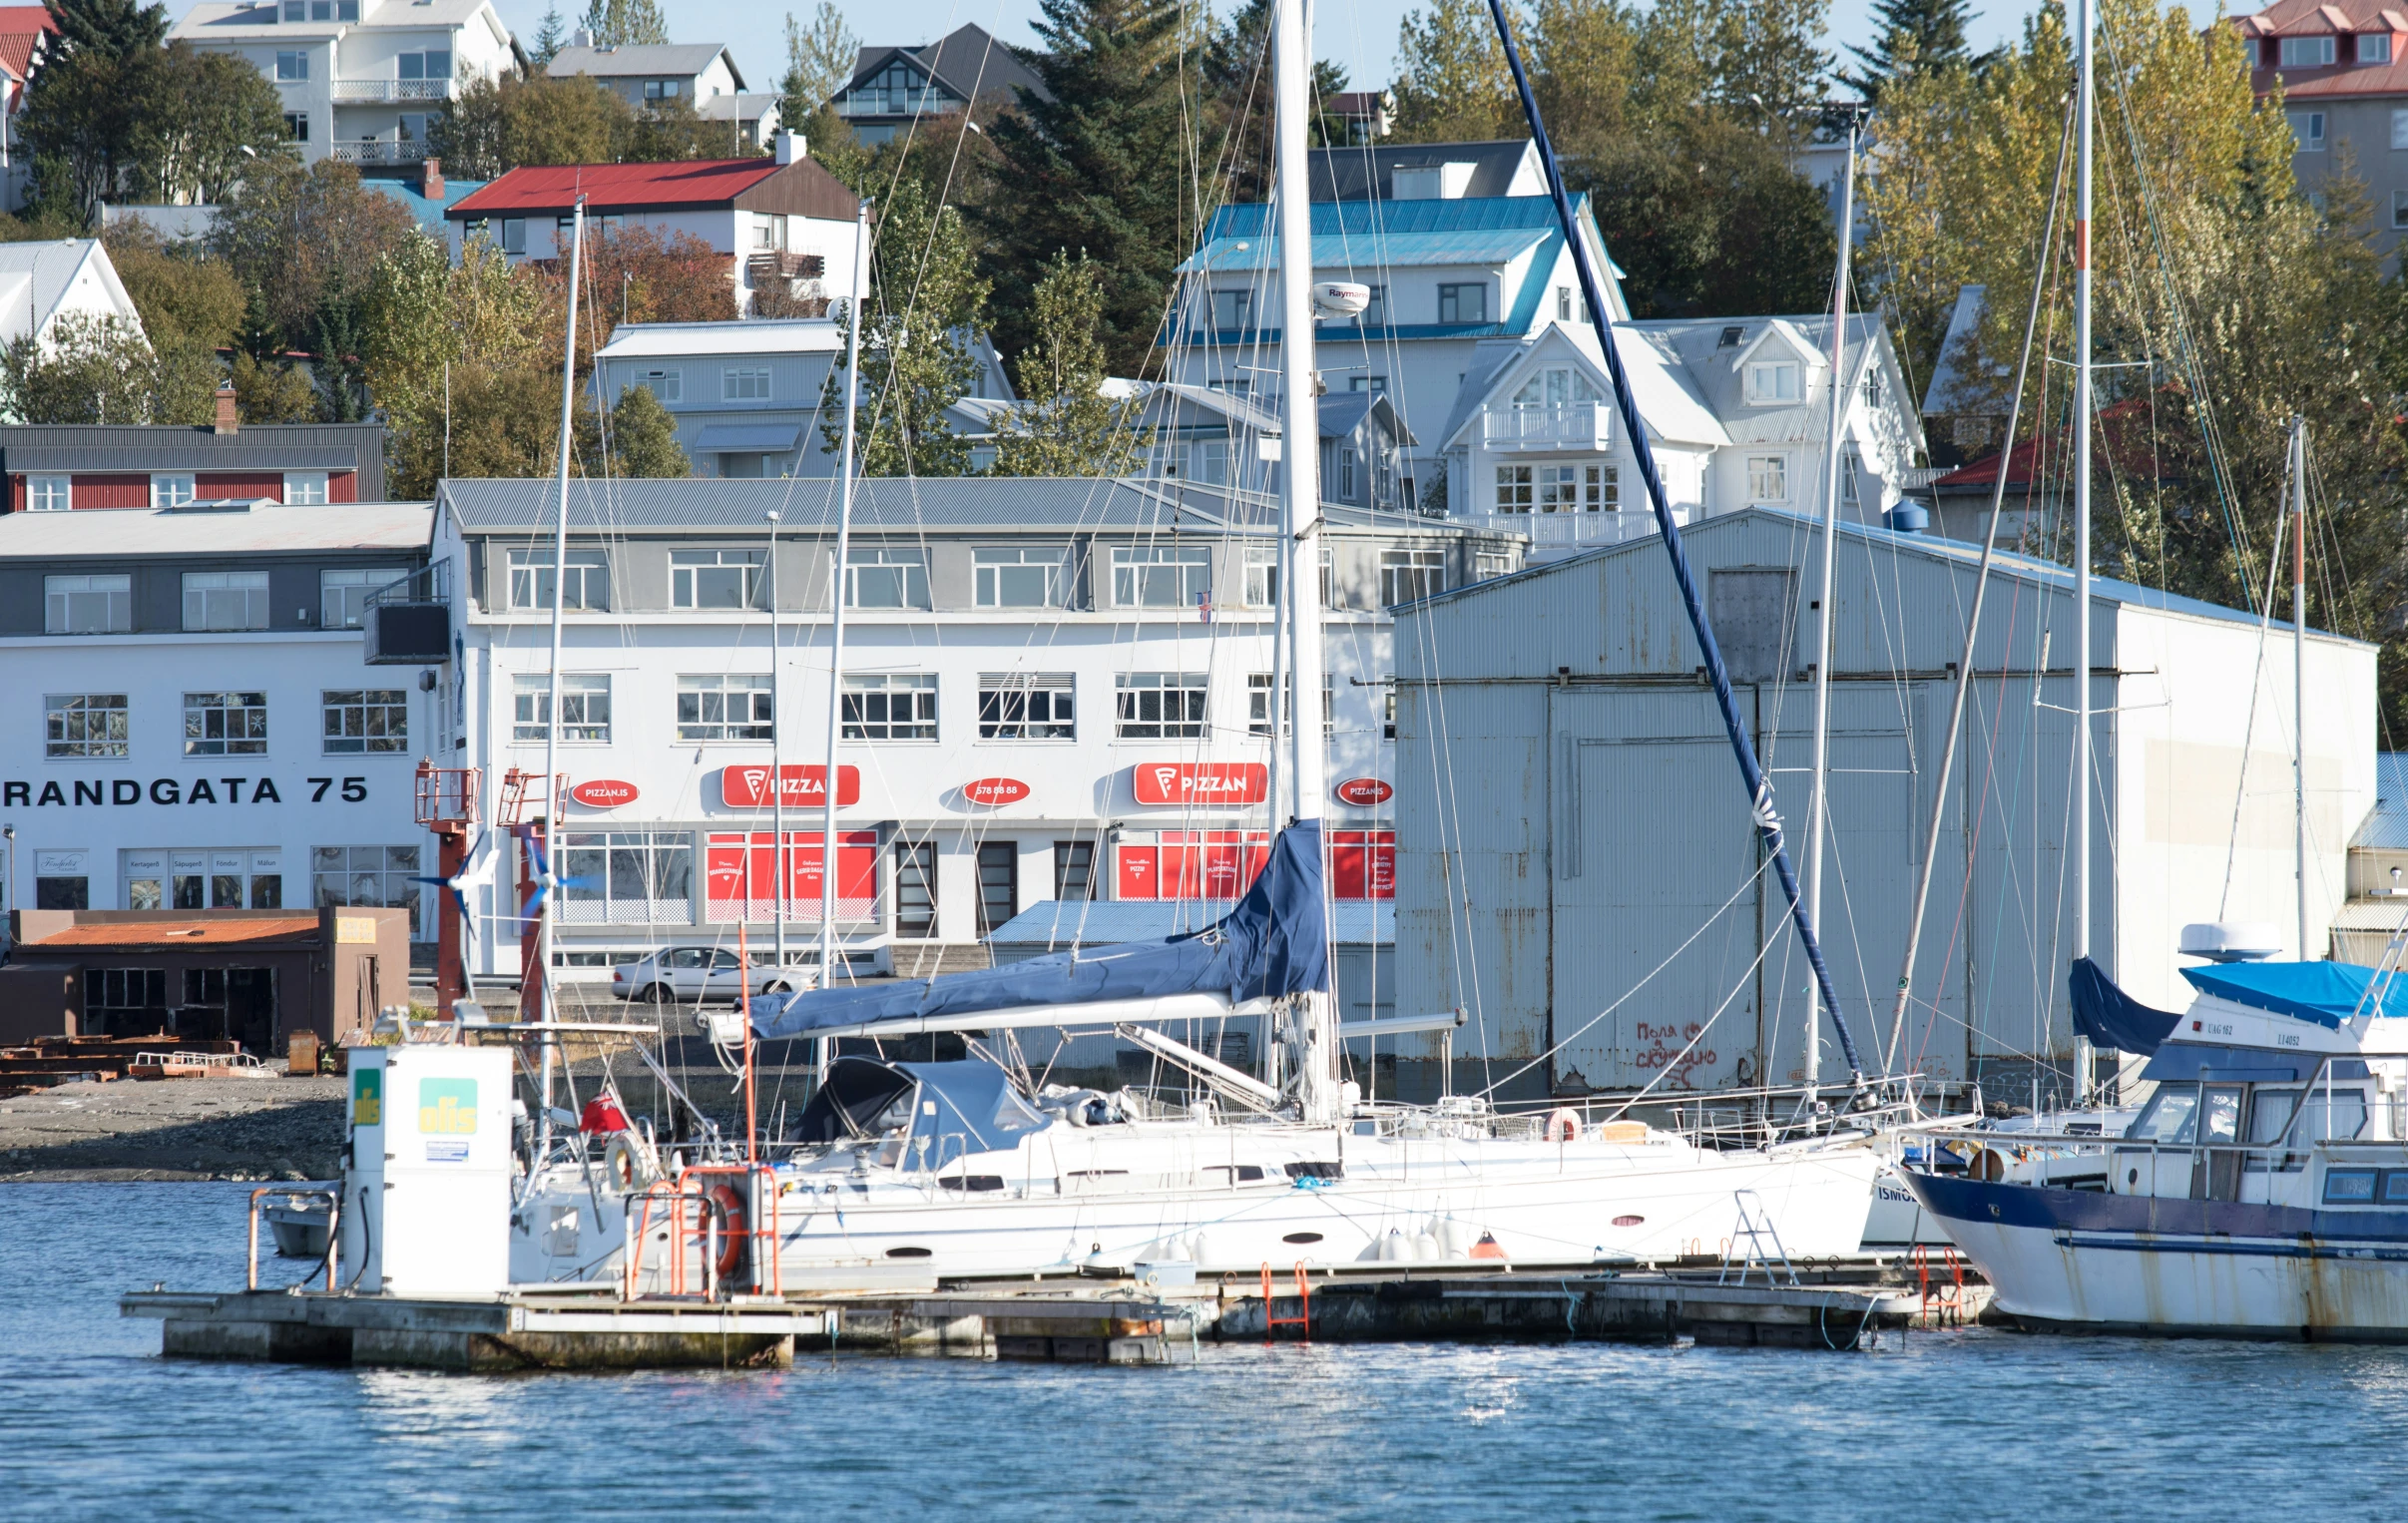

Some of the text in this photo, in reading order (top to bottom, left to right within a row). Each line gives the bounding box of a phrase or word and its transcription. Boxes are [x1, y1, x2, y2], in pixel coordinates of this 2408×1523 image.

[1328, 288, 1369, 298] Raymarine
[1183, 776, 1247, 791] PIZZAN
[3, 776, 368, 806] RANDGATA 75
[585, 788, 629, 797] PIZZAN.IS
[1006, 785, 1018, 794] 88
[130, 860, 160, 869] Kertagerð
[174, 860, 203, 869] Sápugerð
[2222, 1024, 2233, 1036] 162
